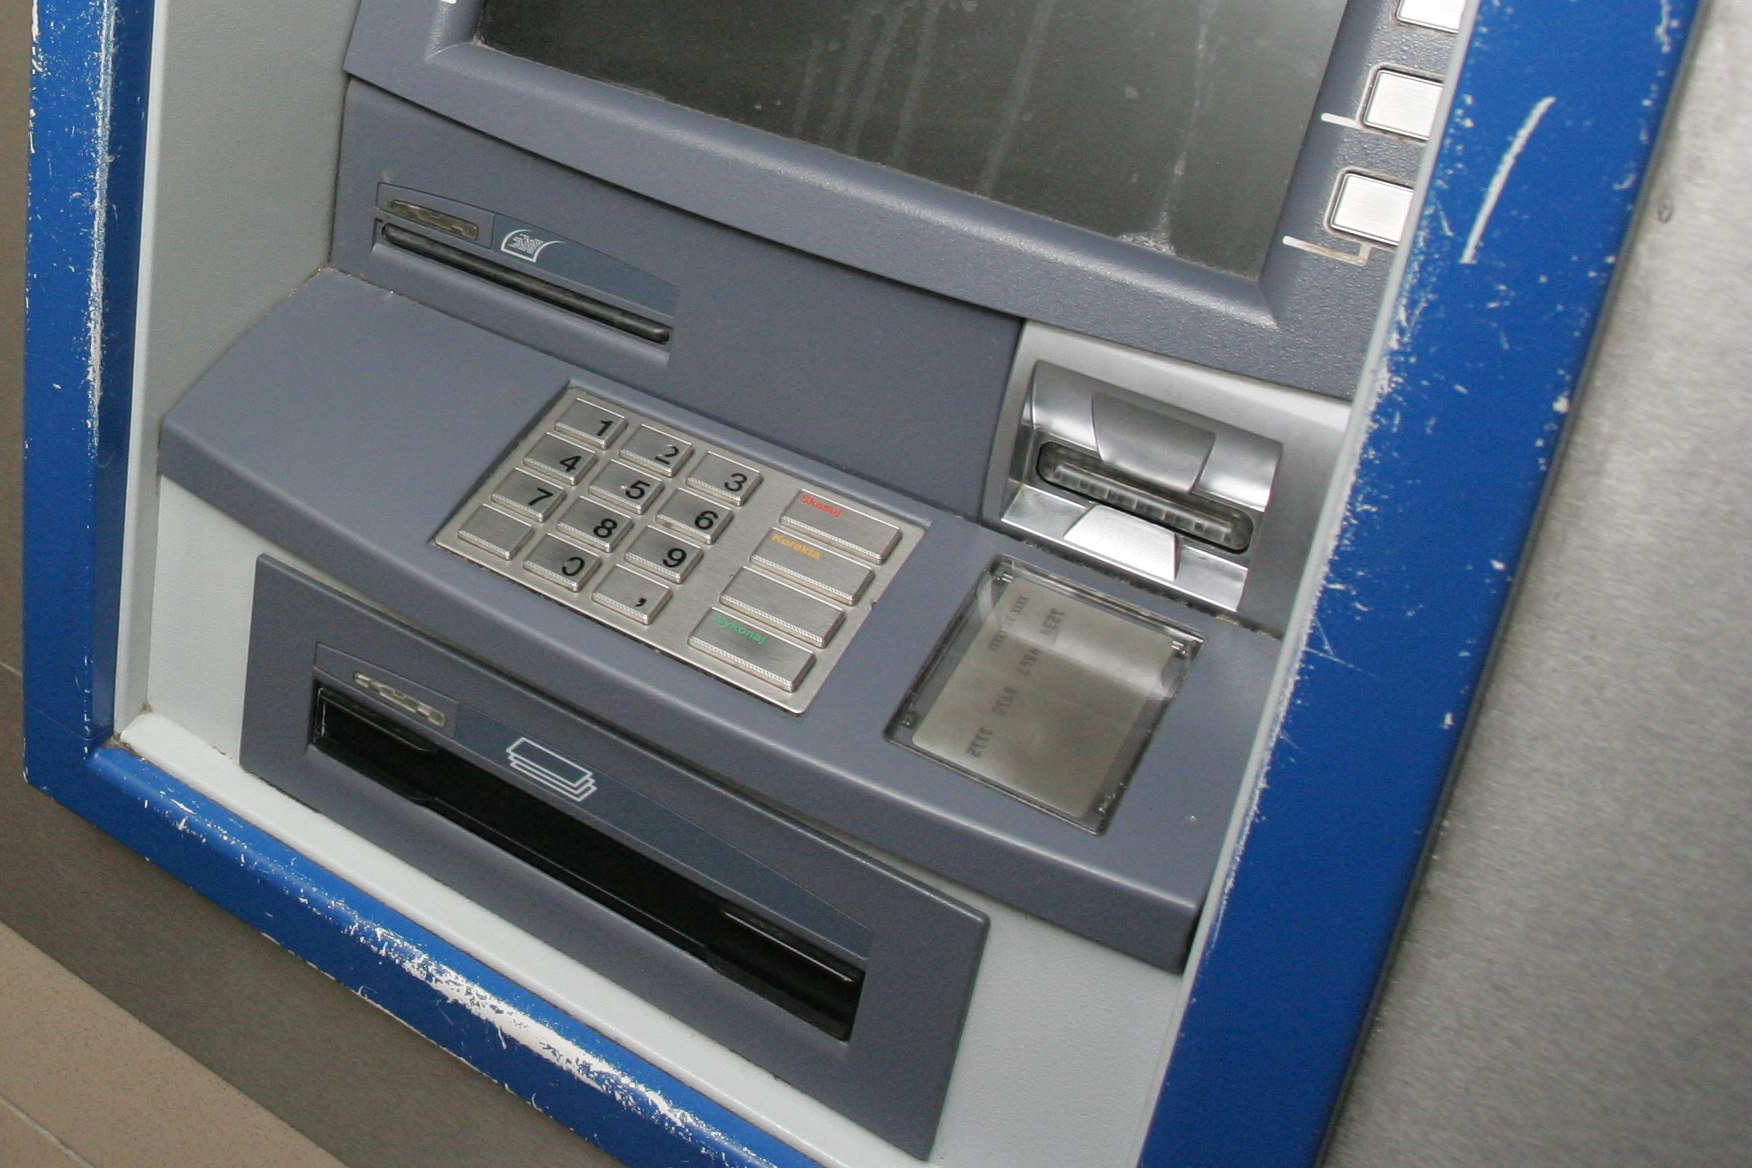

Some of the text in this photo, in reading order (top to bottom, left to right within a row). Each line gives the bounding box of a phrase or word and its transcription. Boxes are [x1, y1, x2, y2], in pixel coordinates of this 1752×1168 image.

[596, 420, 613, 437] 1
[559, 455, 582, 472] 4
[654, 444, 679, 465] 2
[625, 479, 650, 500] 5
[724, 472, 748, 492] 3
[527, 487, 554, 507] 7
[800, 493, 843, 519] Skasuj
[593, 517, 618, 539] 8
[694, 510, 719, 531] 6
[771, 532, 822, 561] Korekta
[662, 547, 687, 568] 9
